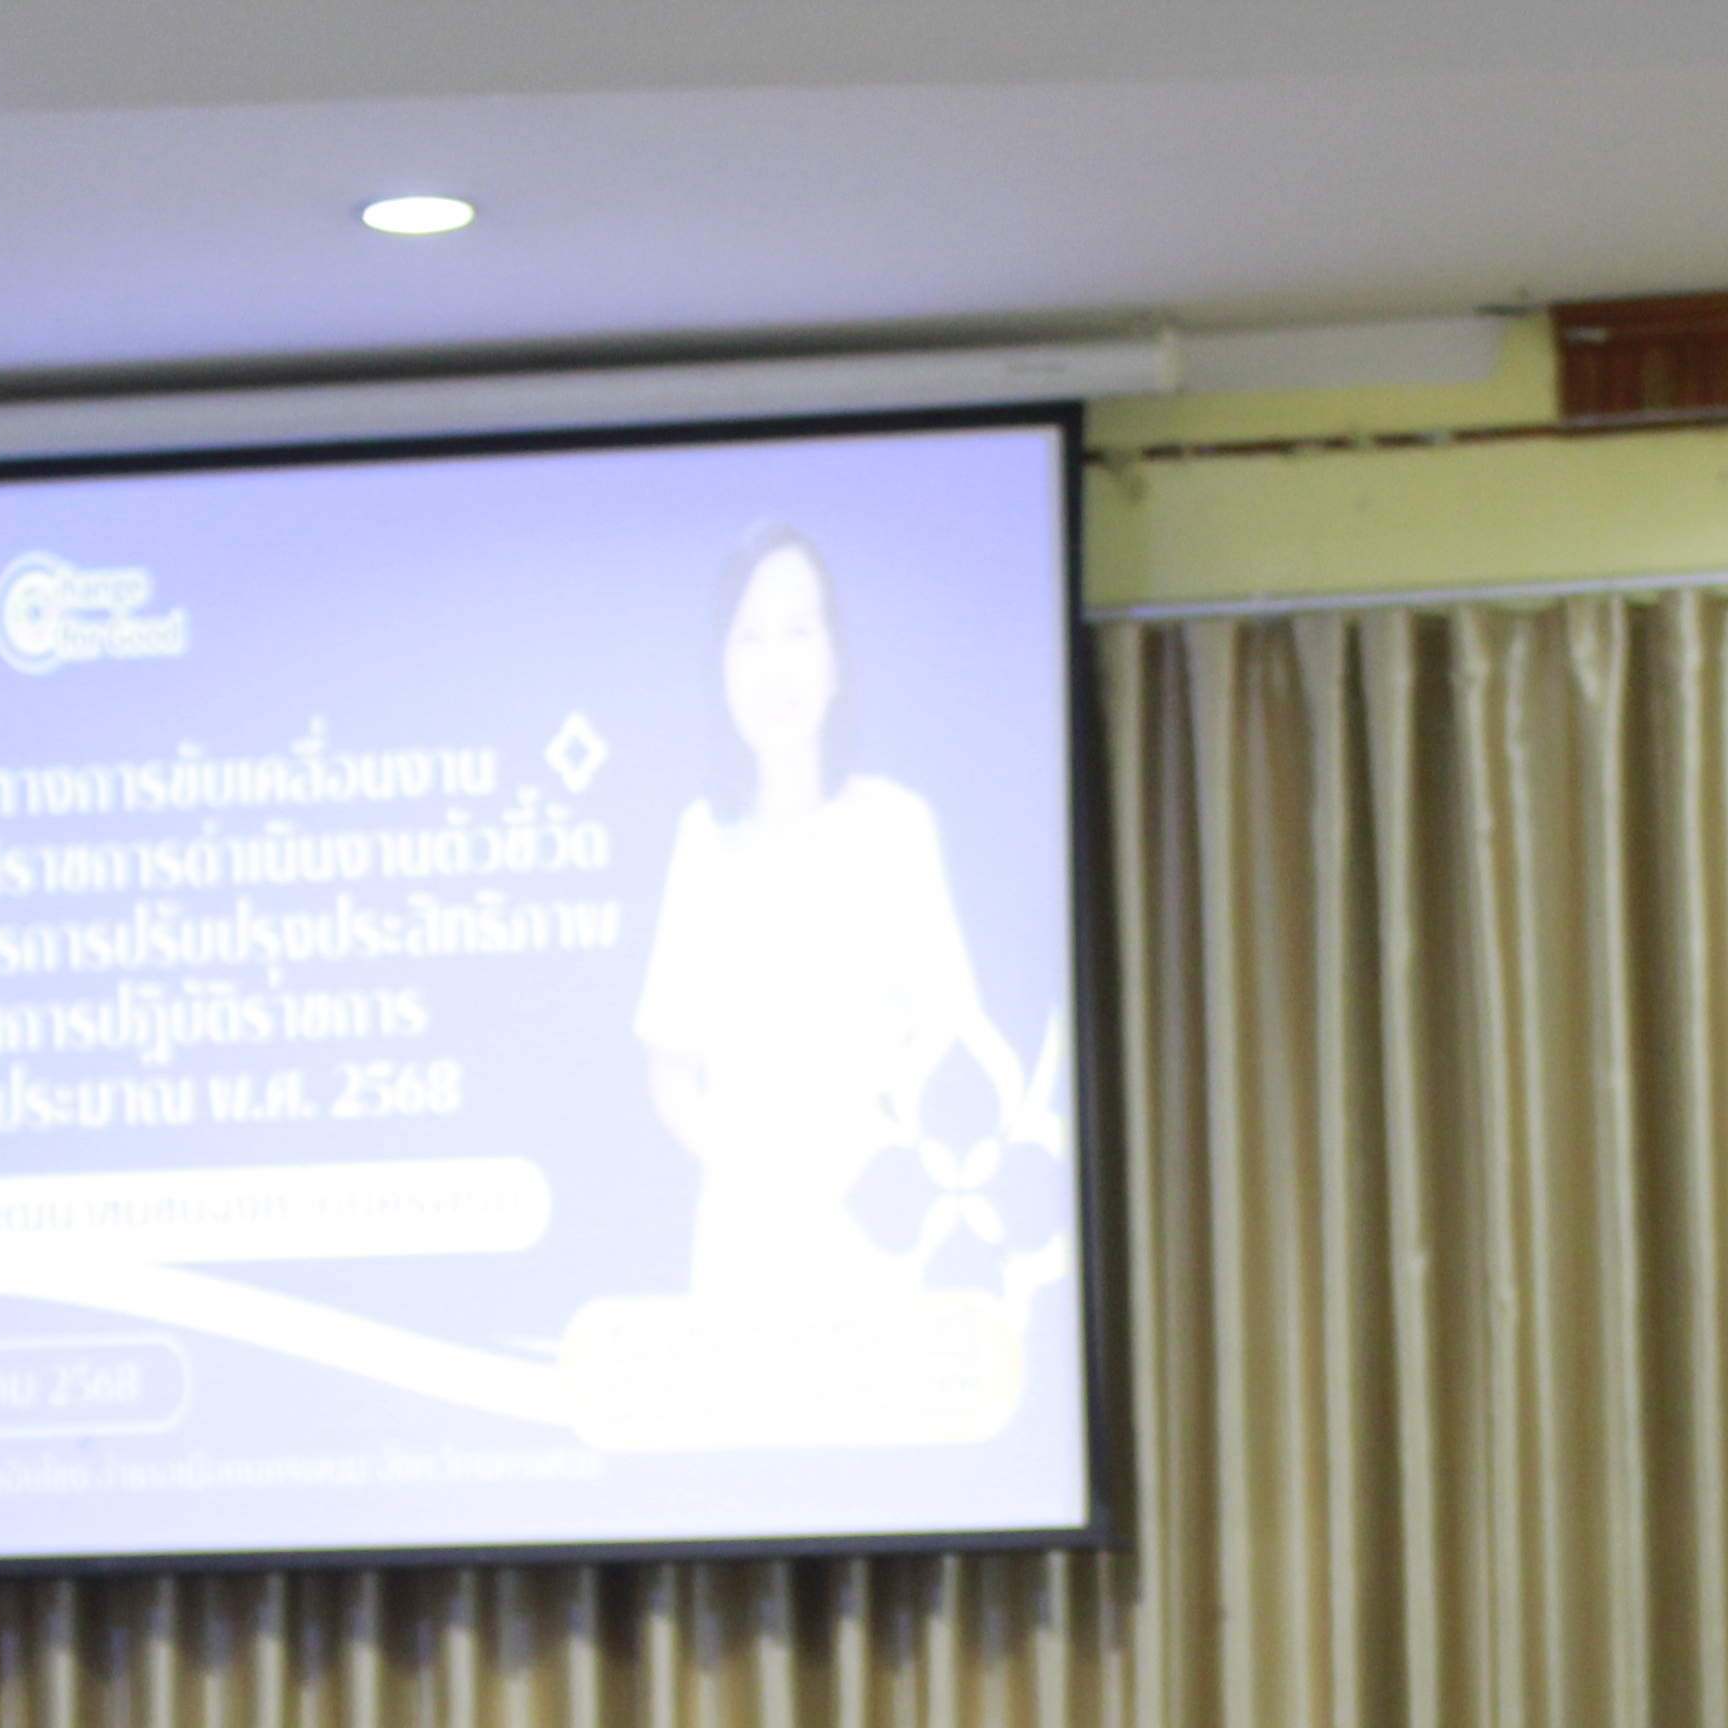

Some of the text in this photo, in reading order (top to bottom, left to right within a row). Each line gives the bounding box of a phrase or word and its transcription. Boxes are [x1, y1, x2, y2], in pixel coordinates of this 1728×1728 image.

[207, 1073, 316, 1124] พ.ศ.
[331, 1058, 463, 1118] 2568
[47, 1361, 141, 1407] 2568
